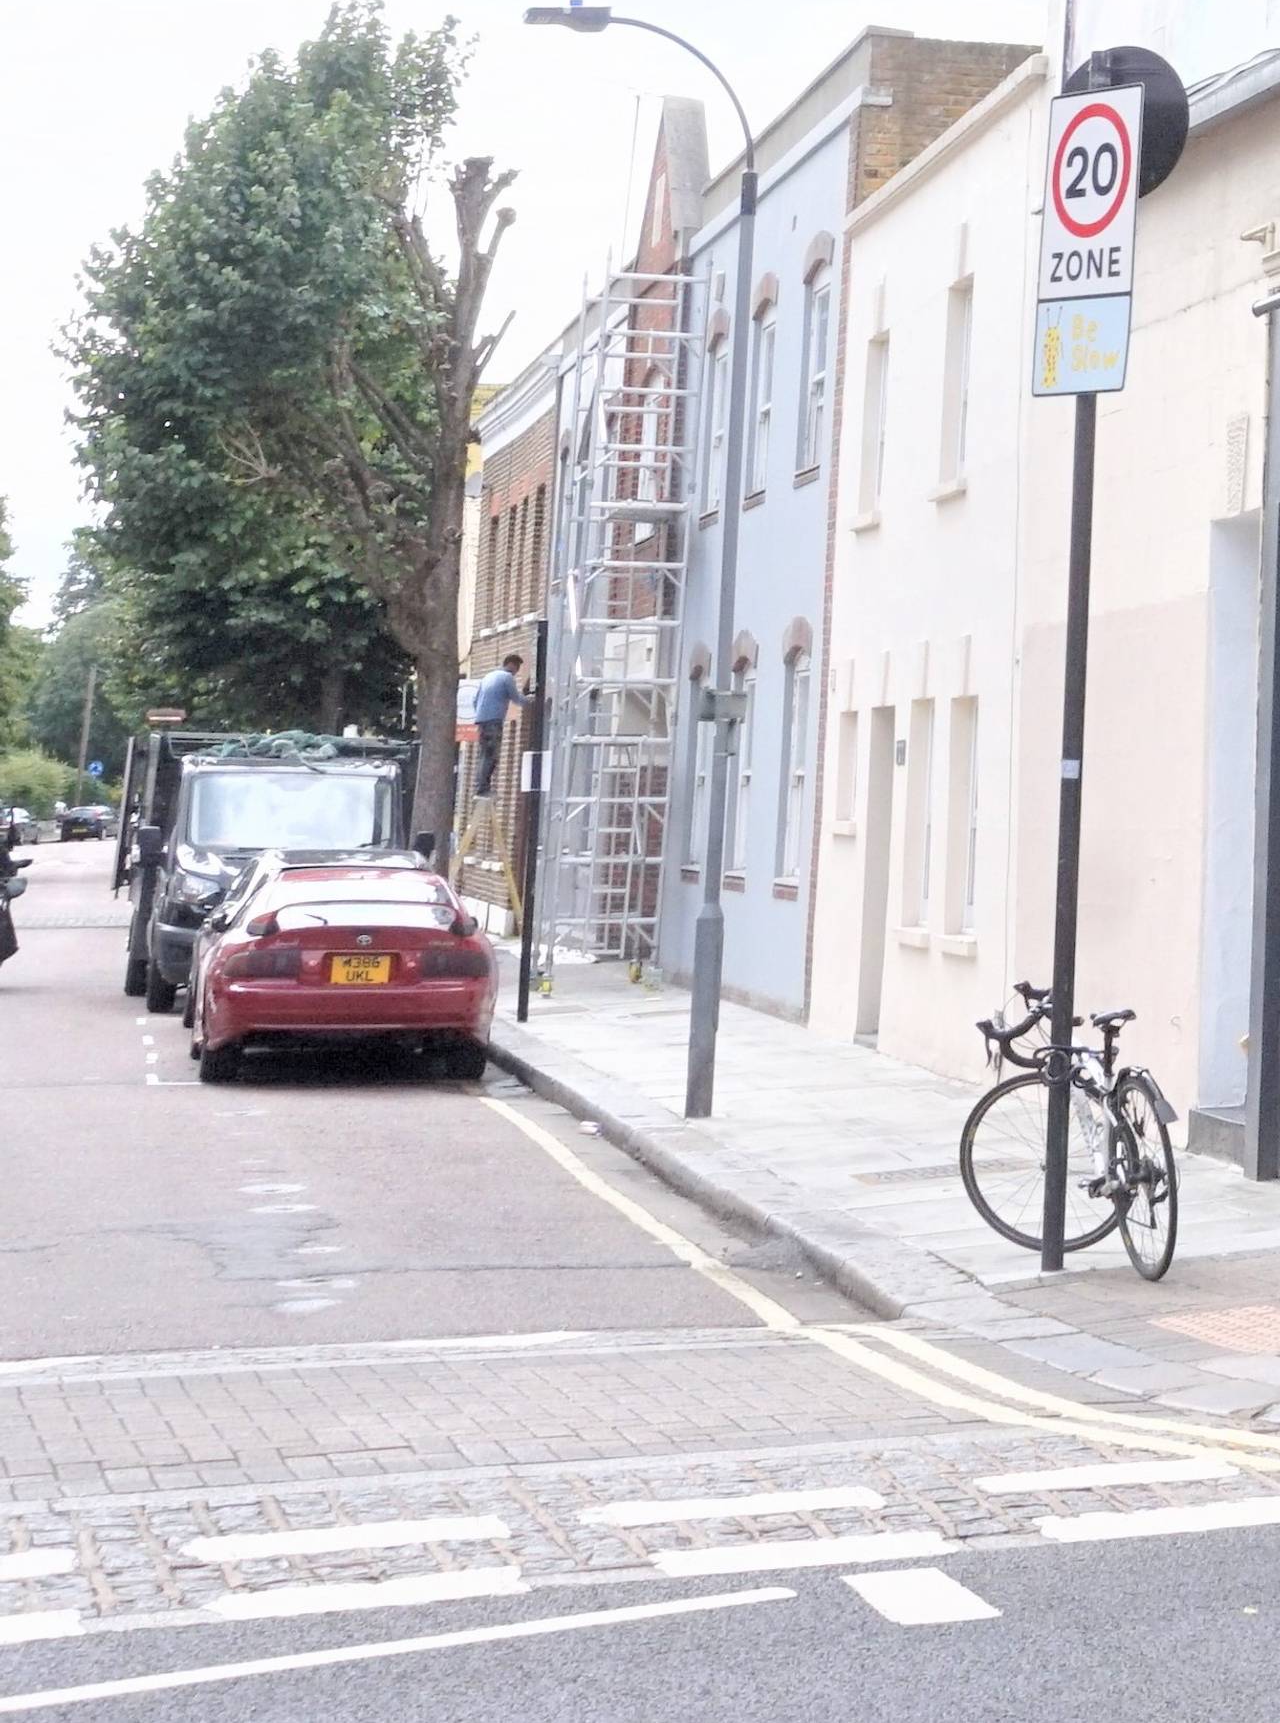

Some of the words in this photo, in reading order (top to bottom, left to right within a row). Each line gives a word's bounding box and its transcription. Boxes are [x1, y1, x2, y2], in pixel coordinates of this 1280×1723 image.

[1065, 142, 1118, 199] 20
[1050, 246, 1121, 282] ZONE
[1071, 313, 1097, 342] Be
[1071, 343, 1120, 372] Slow
